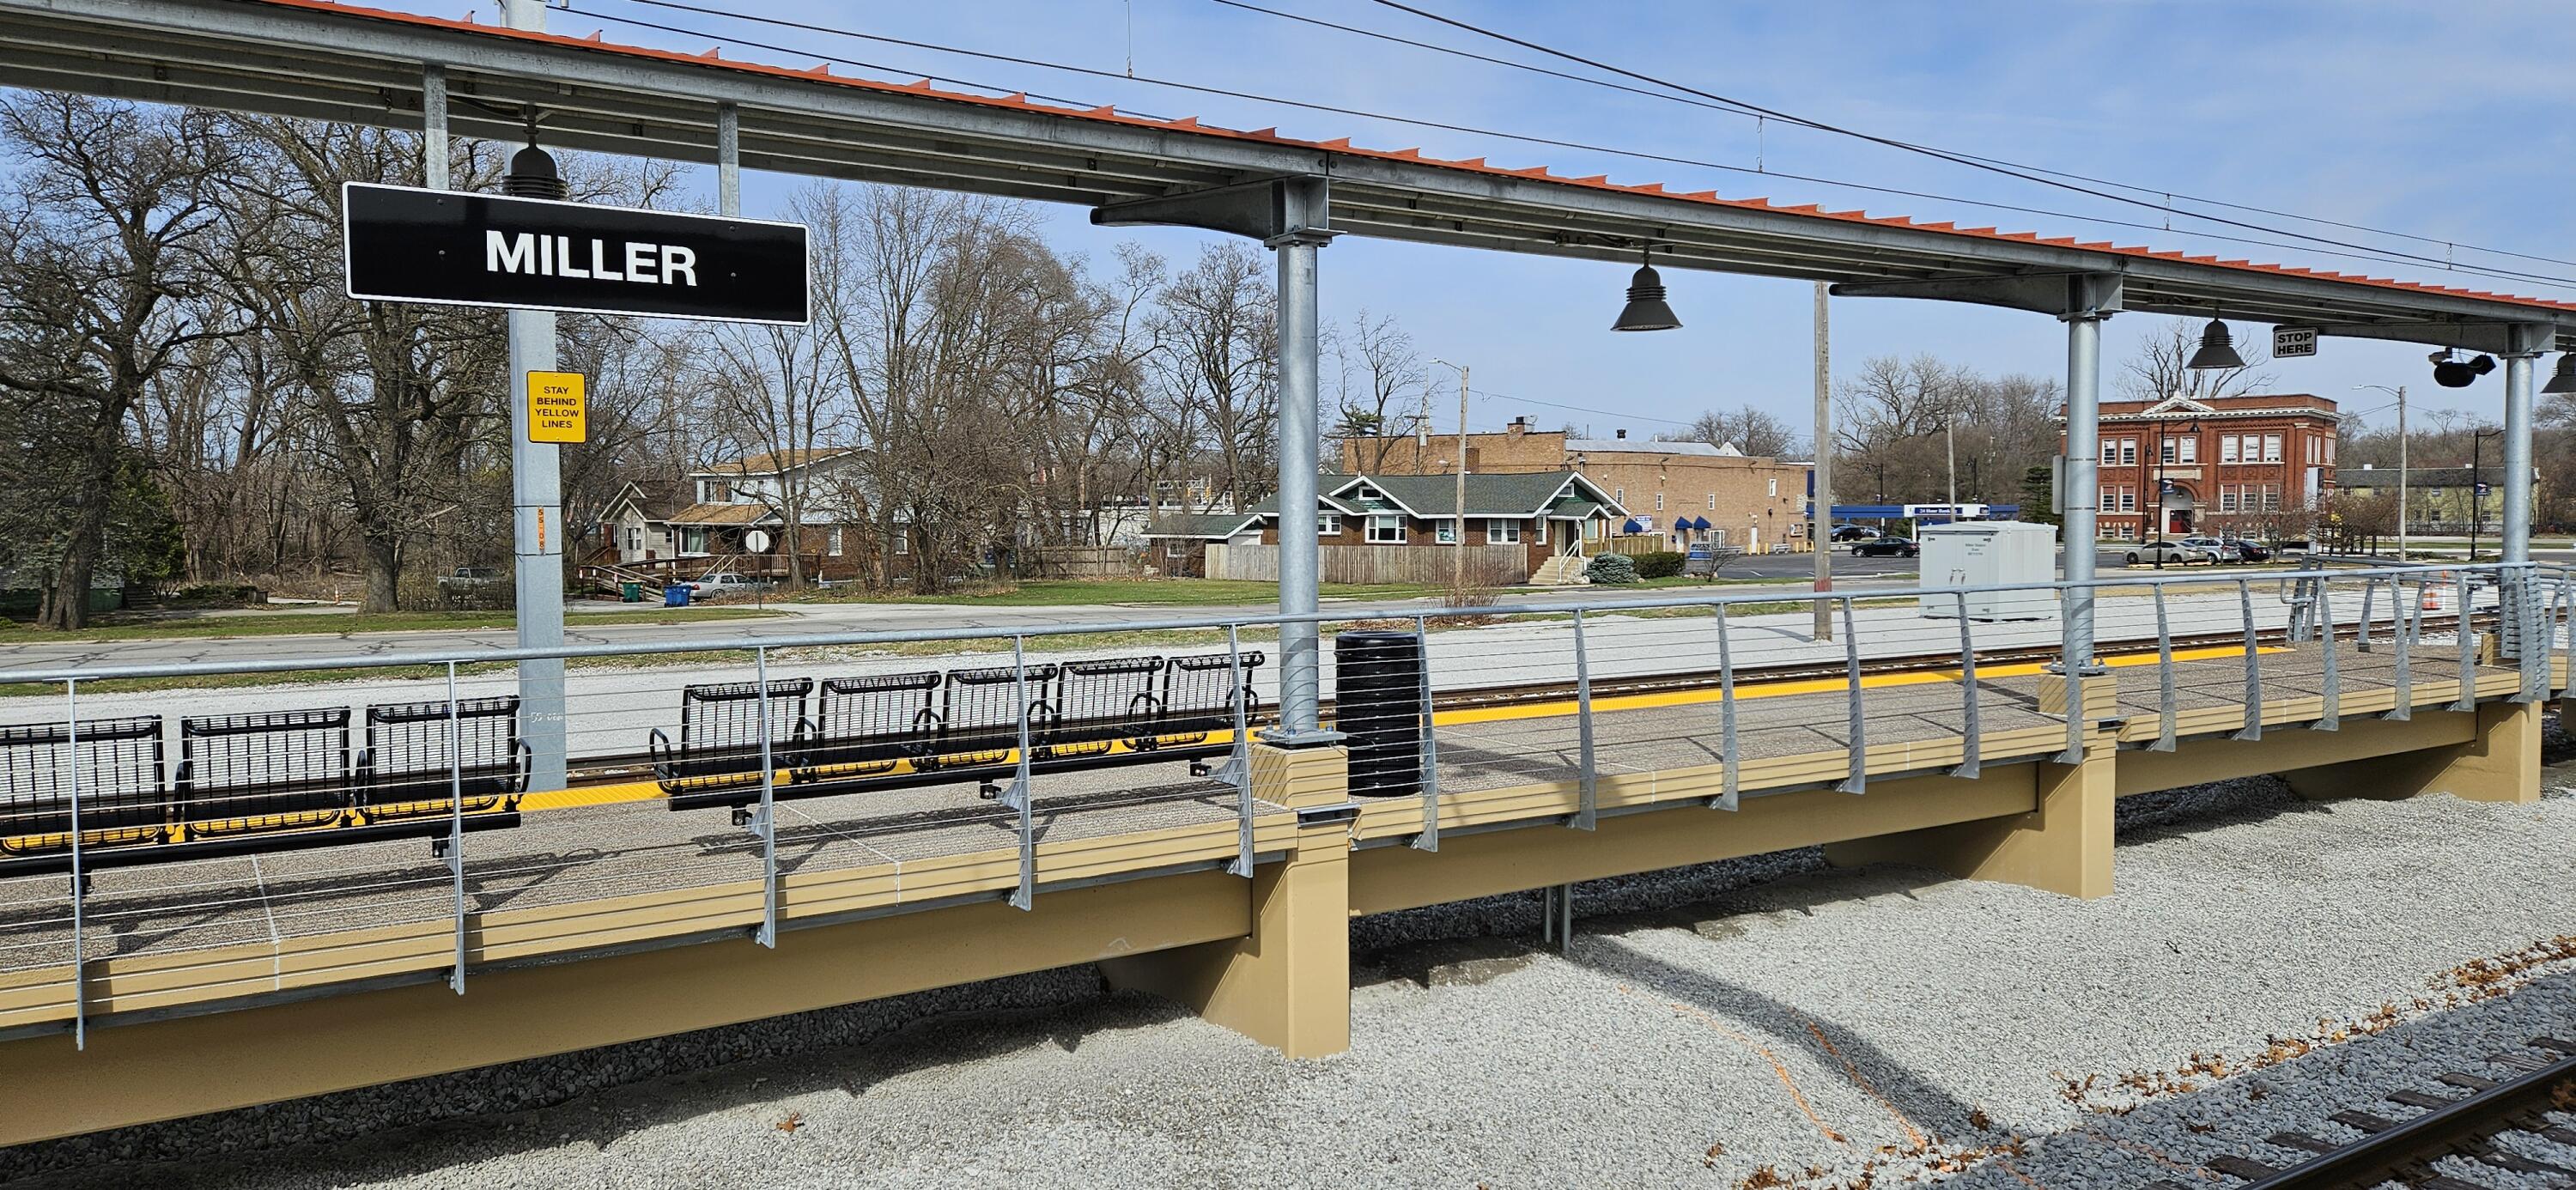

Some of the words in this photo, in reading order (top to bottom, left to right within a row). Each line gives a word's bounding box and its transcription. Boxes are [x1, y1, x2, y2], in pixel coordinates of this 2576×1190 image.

[486, 230, 697, 287] MILLER
[2277, 332, 2312, 343] STOP
[2277, 343, 2312, 355] HERE
[544, 386, 568, 394] STAY
[537, 397, 576, 406] BEHIND
[535, 409, 579, 417] YELLOW
[542, 420, 573, 428] LINES
